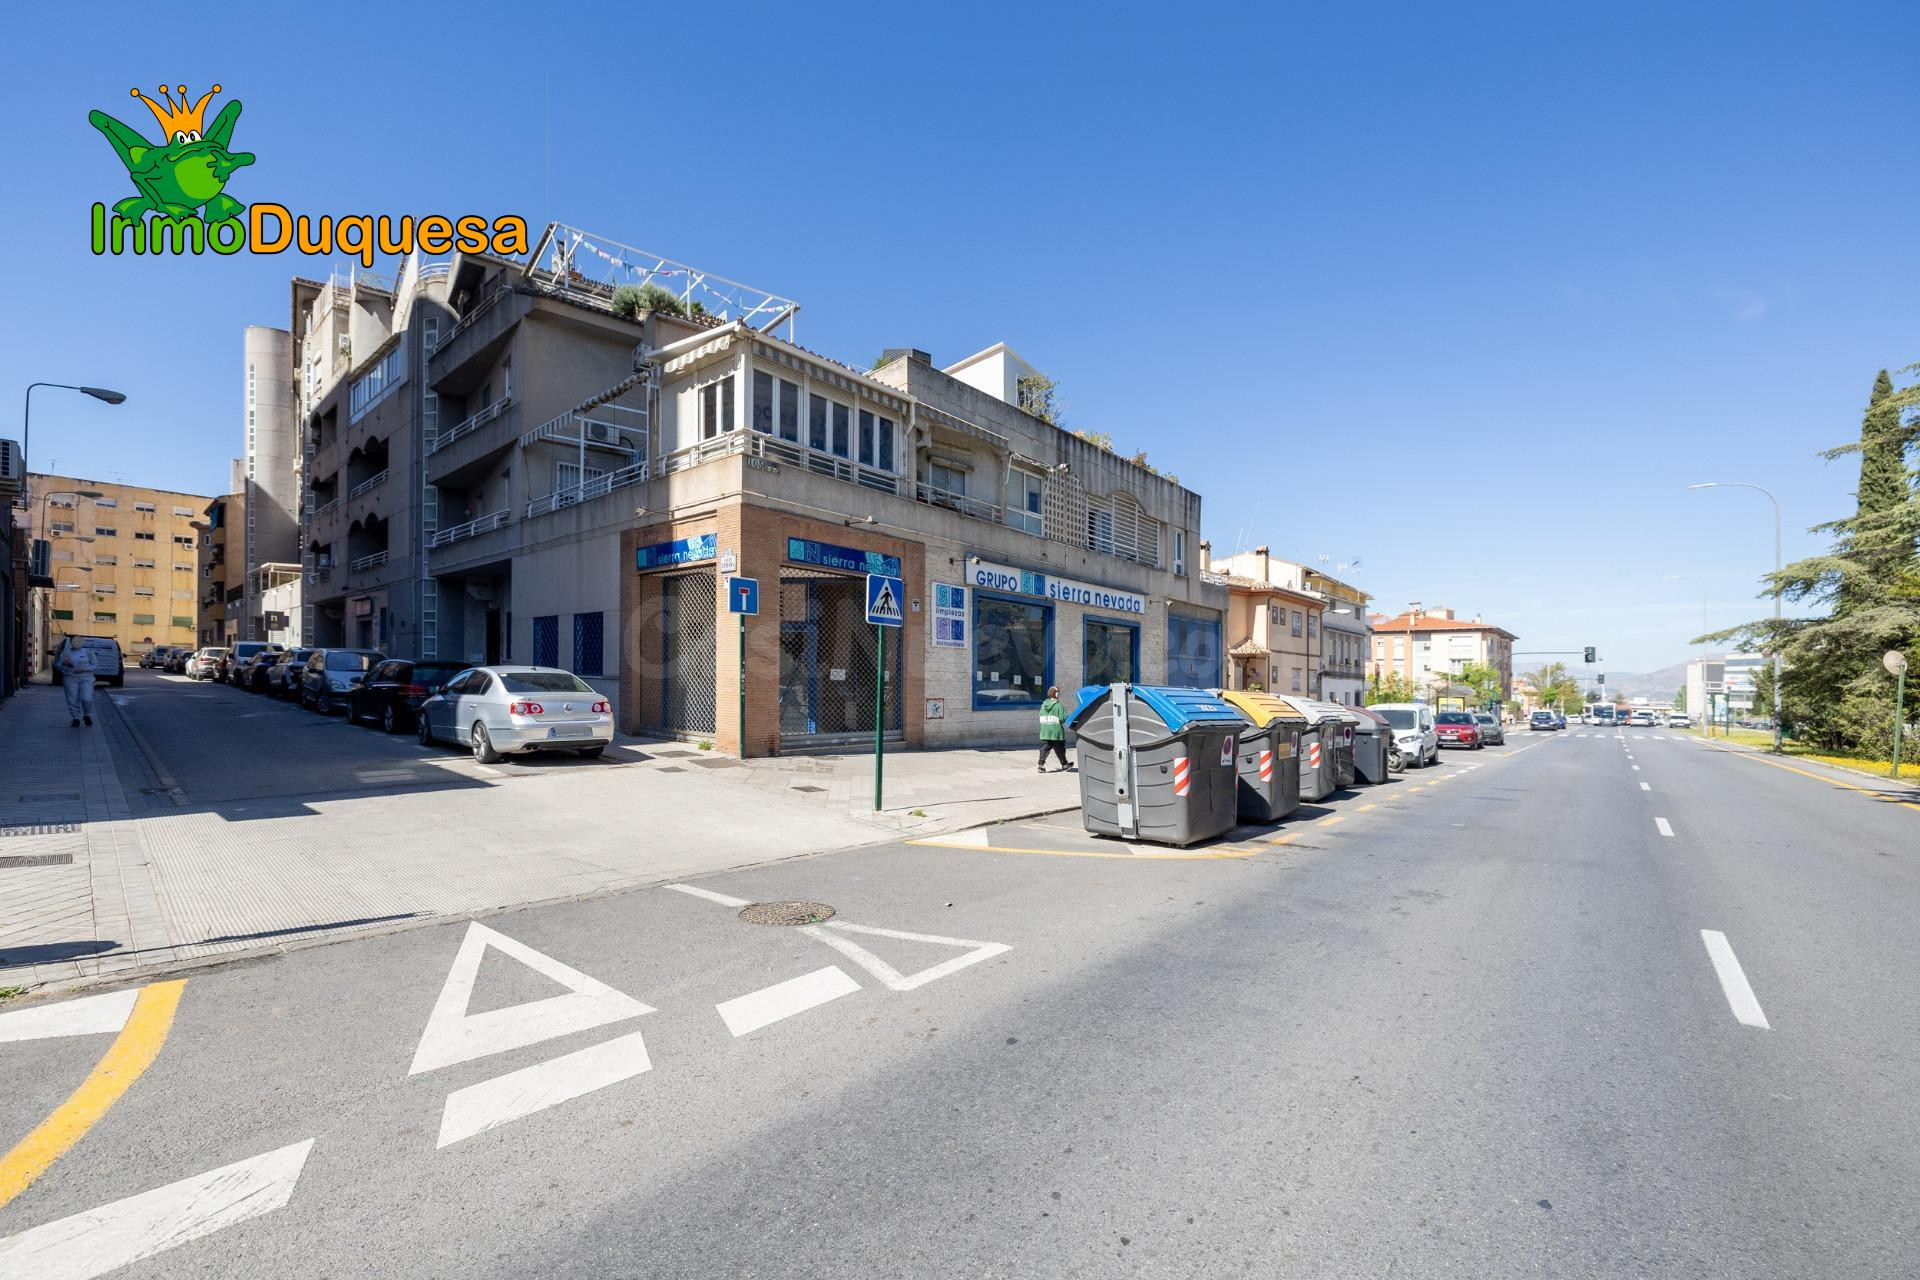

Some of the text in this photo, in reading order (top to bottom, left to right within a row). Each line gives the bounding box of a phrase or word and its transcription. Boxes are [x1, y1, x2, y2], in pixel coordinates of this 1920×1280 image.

[658, 552, 680, 565] sierra
[683, 545, 715, 560] nevada
[822, 554, 855, 569] sierra
[859, 562, 897, 576] nevada
[976, 570, 1017, 591] GRUPO
[1050, 580, 1091, 604] sierra
[1095, 592, 1140, 612] nevada
[936, 607, 965, 617] limpiezas
